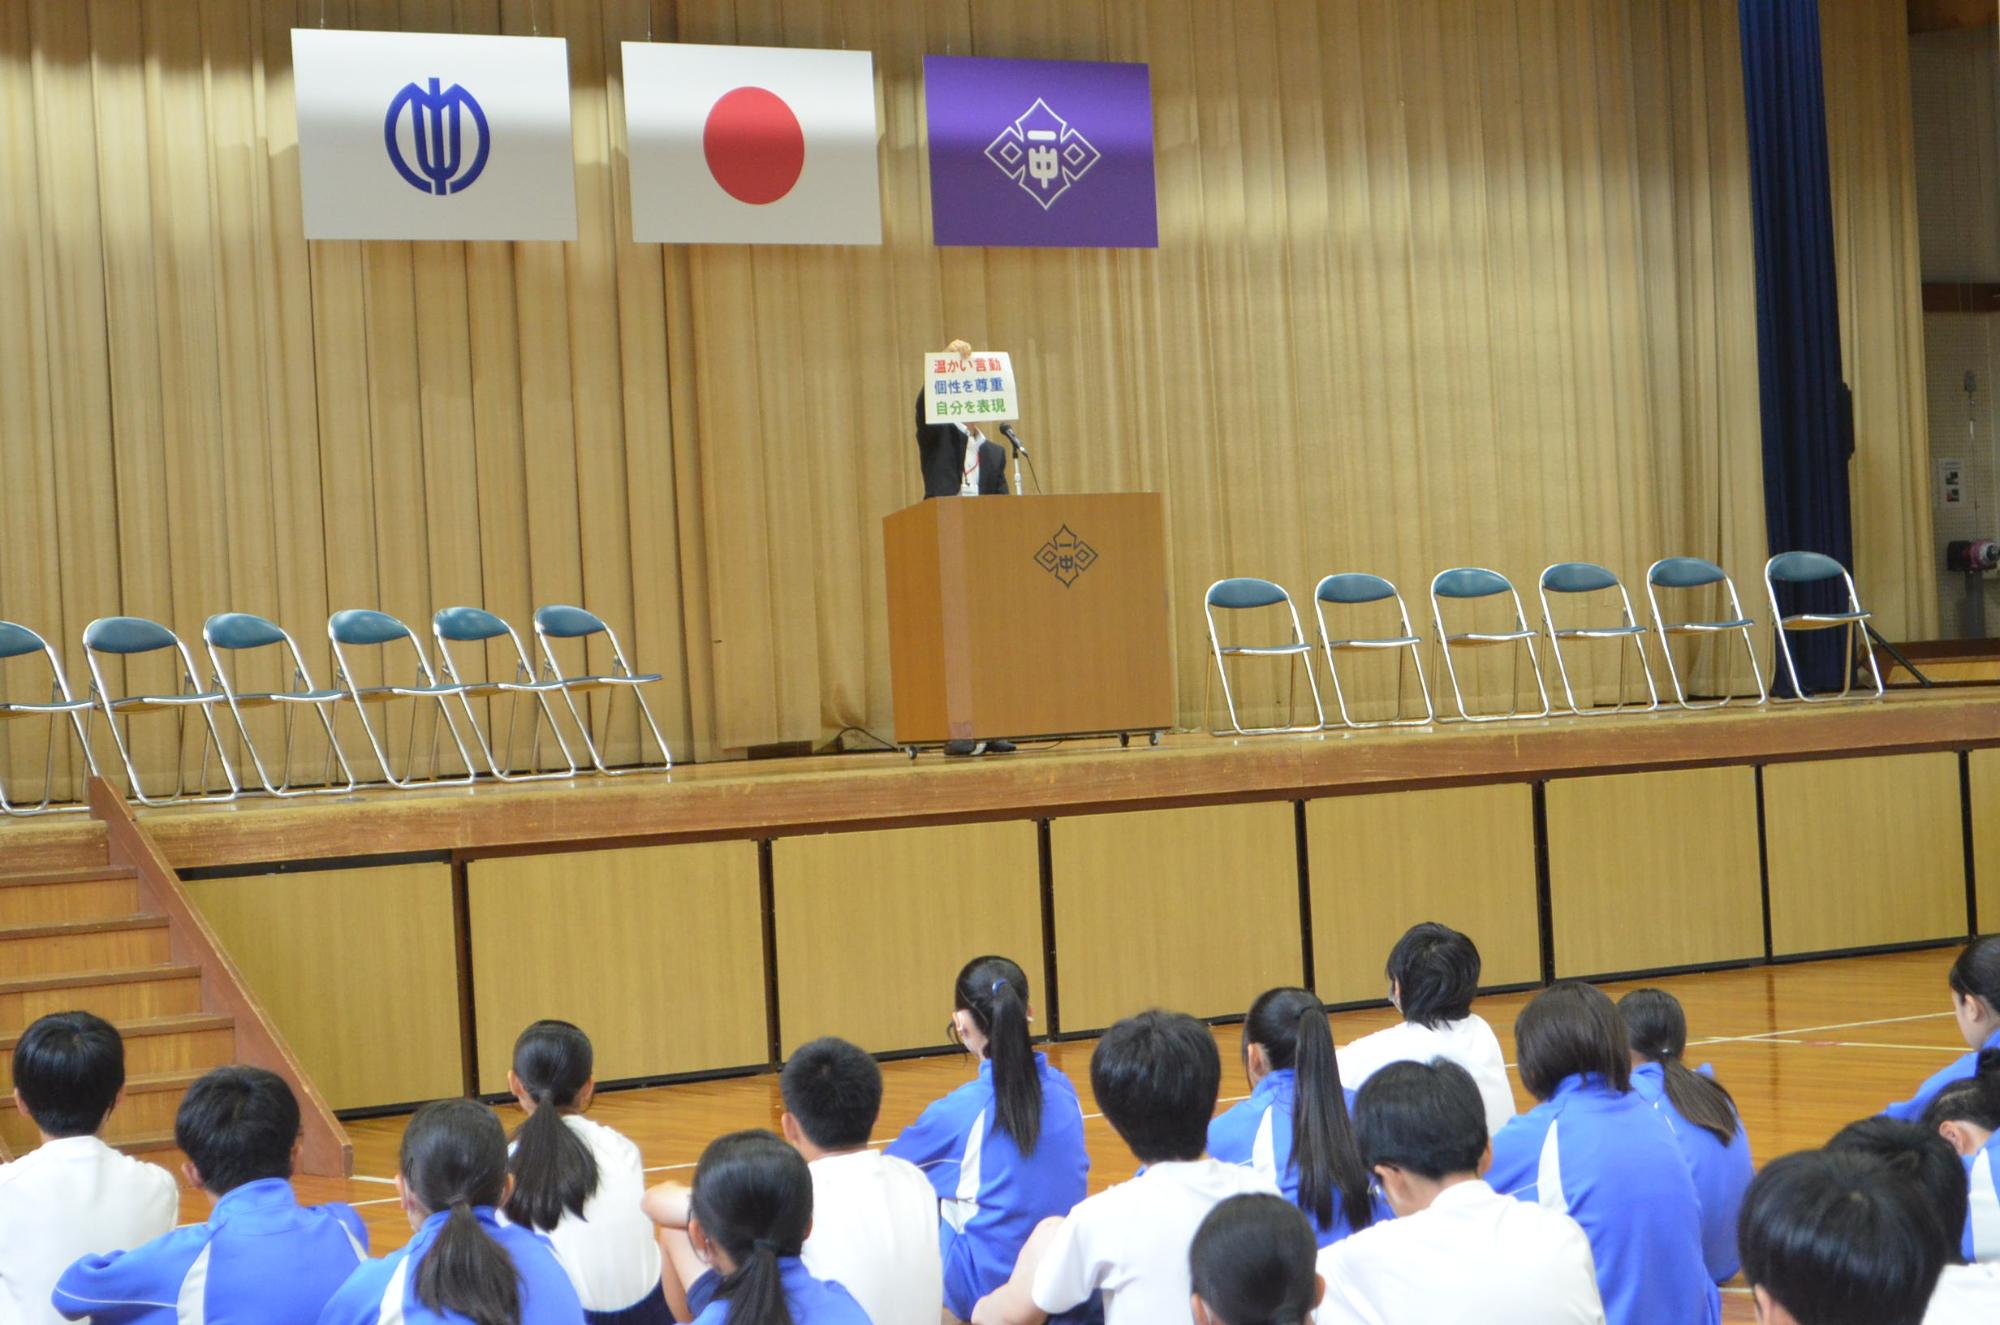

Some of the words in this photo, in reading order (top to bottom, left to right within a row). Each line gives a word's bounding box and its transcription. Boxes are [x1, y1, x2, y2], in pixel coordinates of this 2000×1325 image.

[934, 358, 1002, 374] 温かい言動
[934, 377, 1004, 395] 個性を尊重
[936, 398, 1006, 416] 自分を表現
